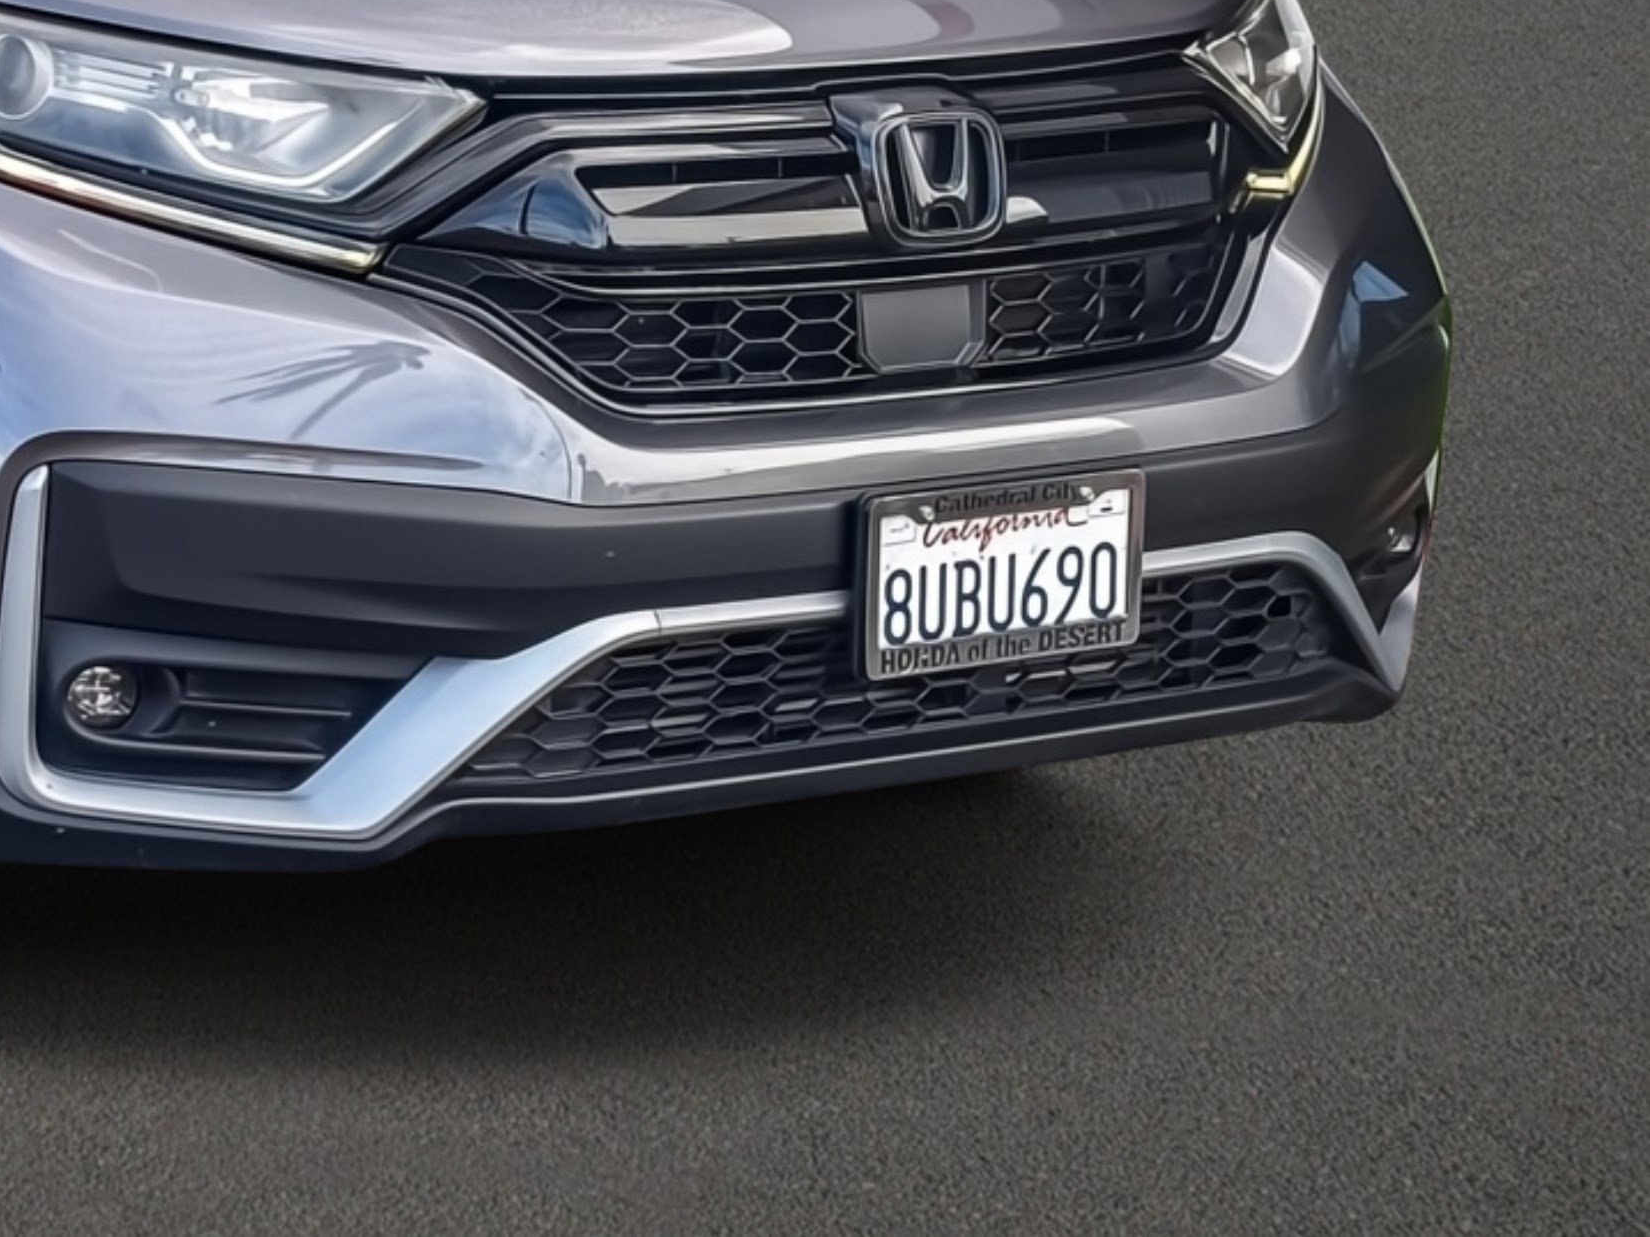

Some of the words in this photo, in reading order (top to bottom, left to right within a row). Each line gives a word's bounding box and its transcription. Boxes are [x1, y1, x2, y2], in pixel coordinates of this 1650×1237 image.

[933, 485, 1035, 513] Cathedral
[923, 507, 1088, 553] California
[883, 541, 1118, 646] 8UBU690
[881, 641, 960, 673] HONDA
[967, 638, 989, 661] of
[997, 633, 1032, 657] the
[1038, 619, 1128, 652] DESERT
